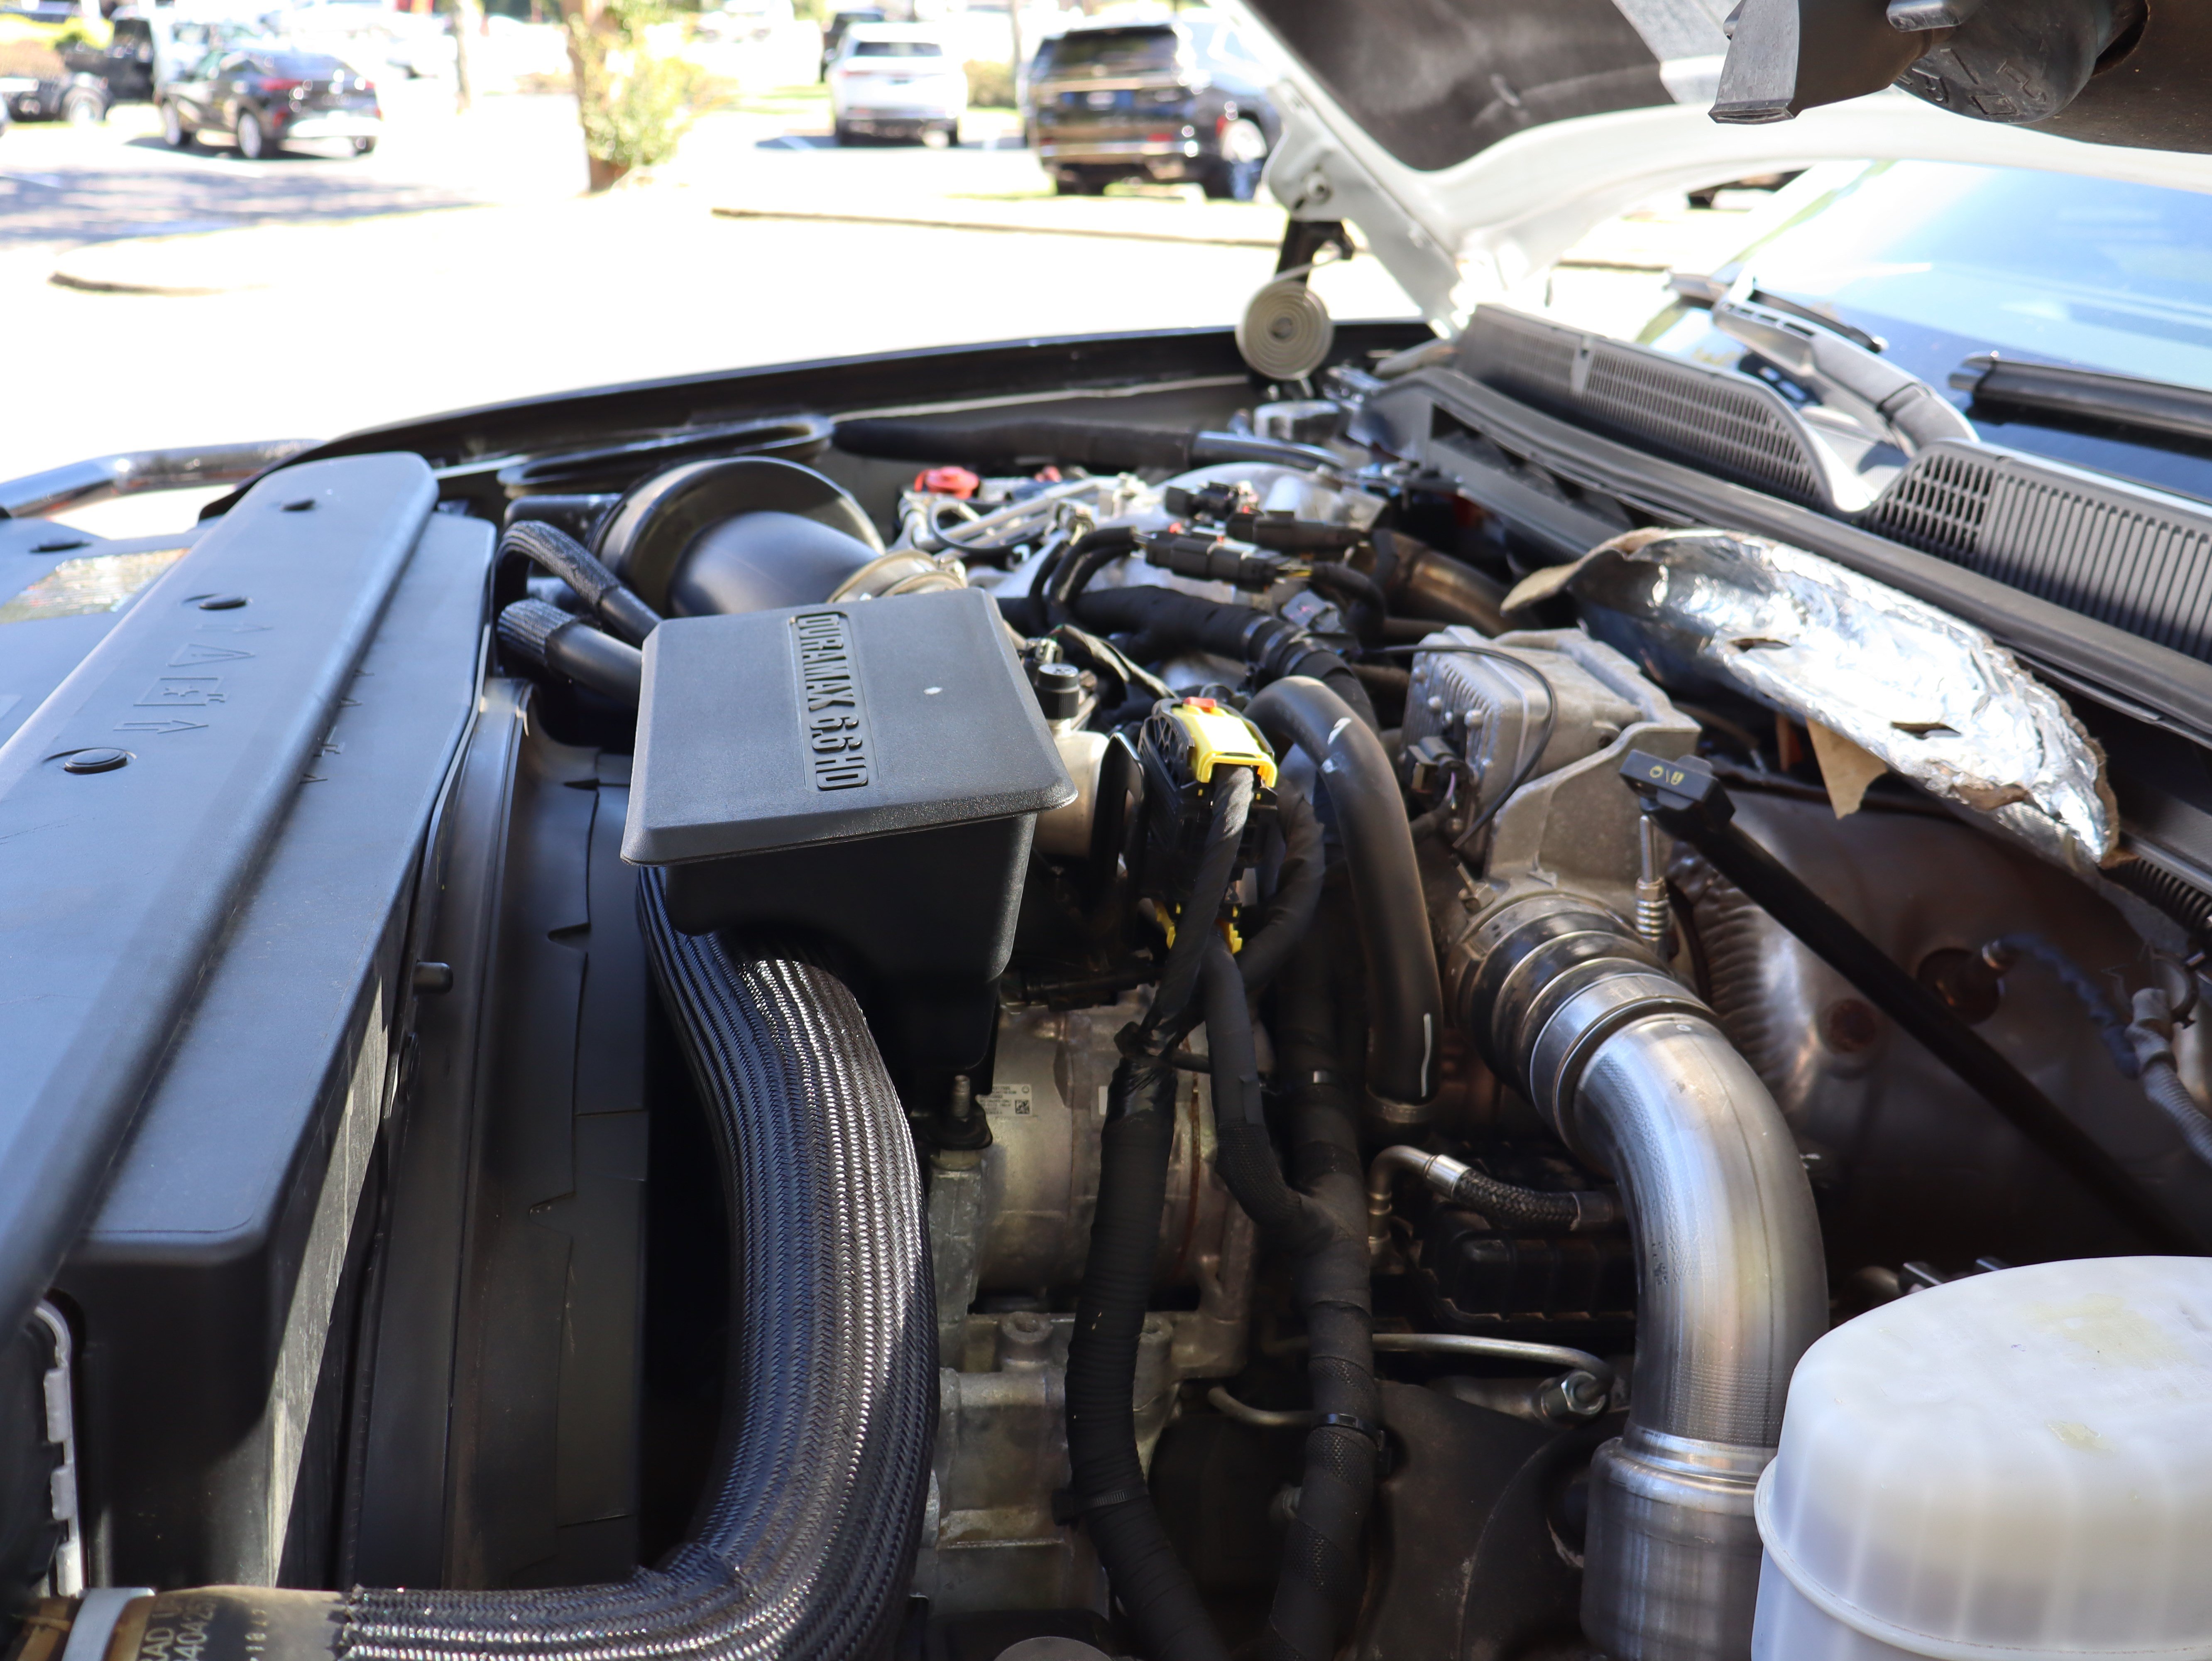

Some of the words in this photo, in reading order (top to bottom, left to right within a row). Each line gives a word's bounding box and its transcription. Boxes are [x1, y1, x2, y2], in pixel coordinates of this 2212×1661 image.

[797, 614, 855, 712] DURAMAX
[809, 713, 863, 754] 6.6
[814, 753, 869, 791] HD
